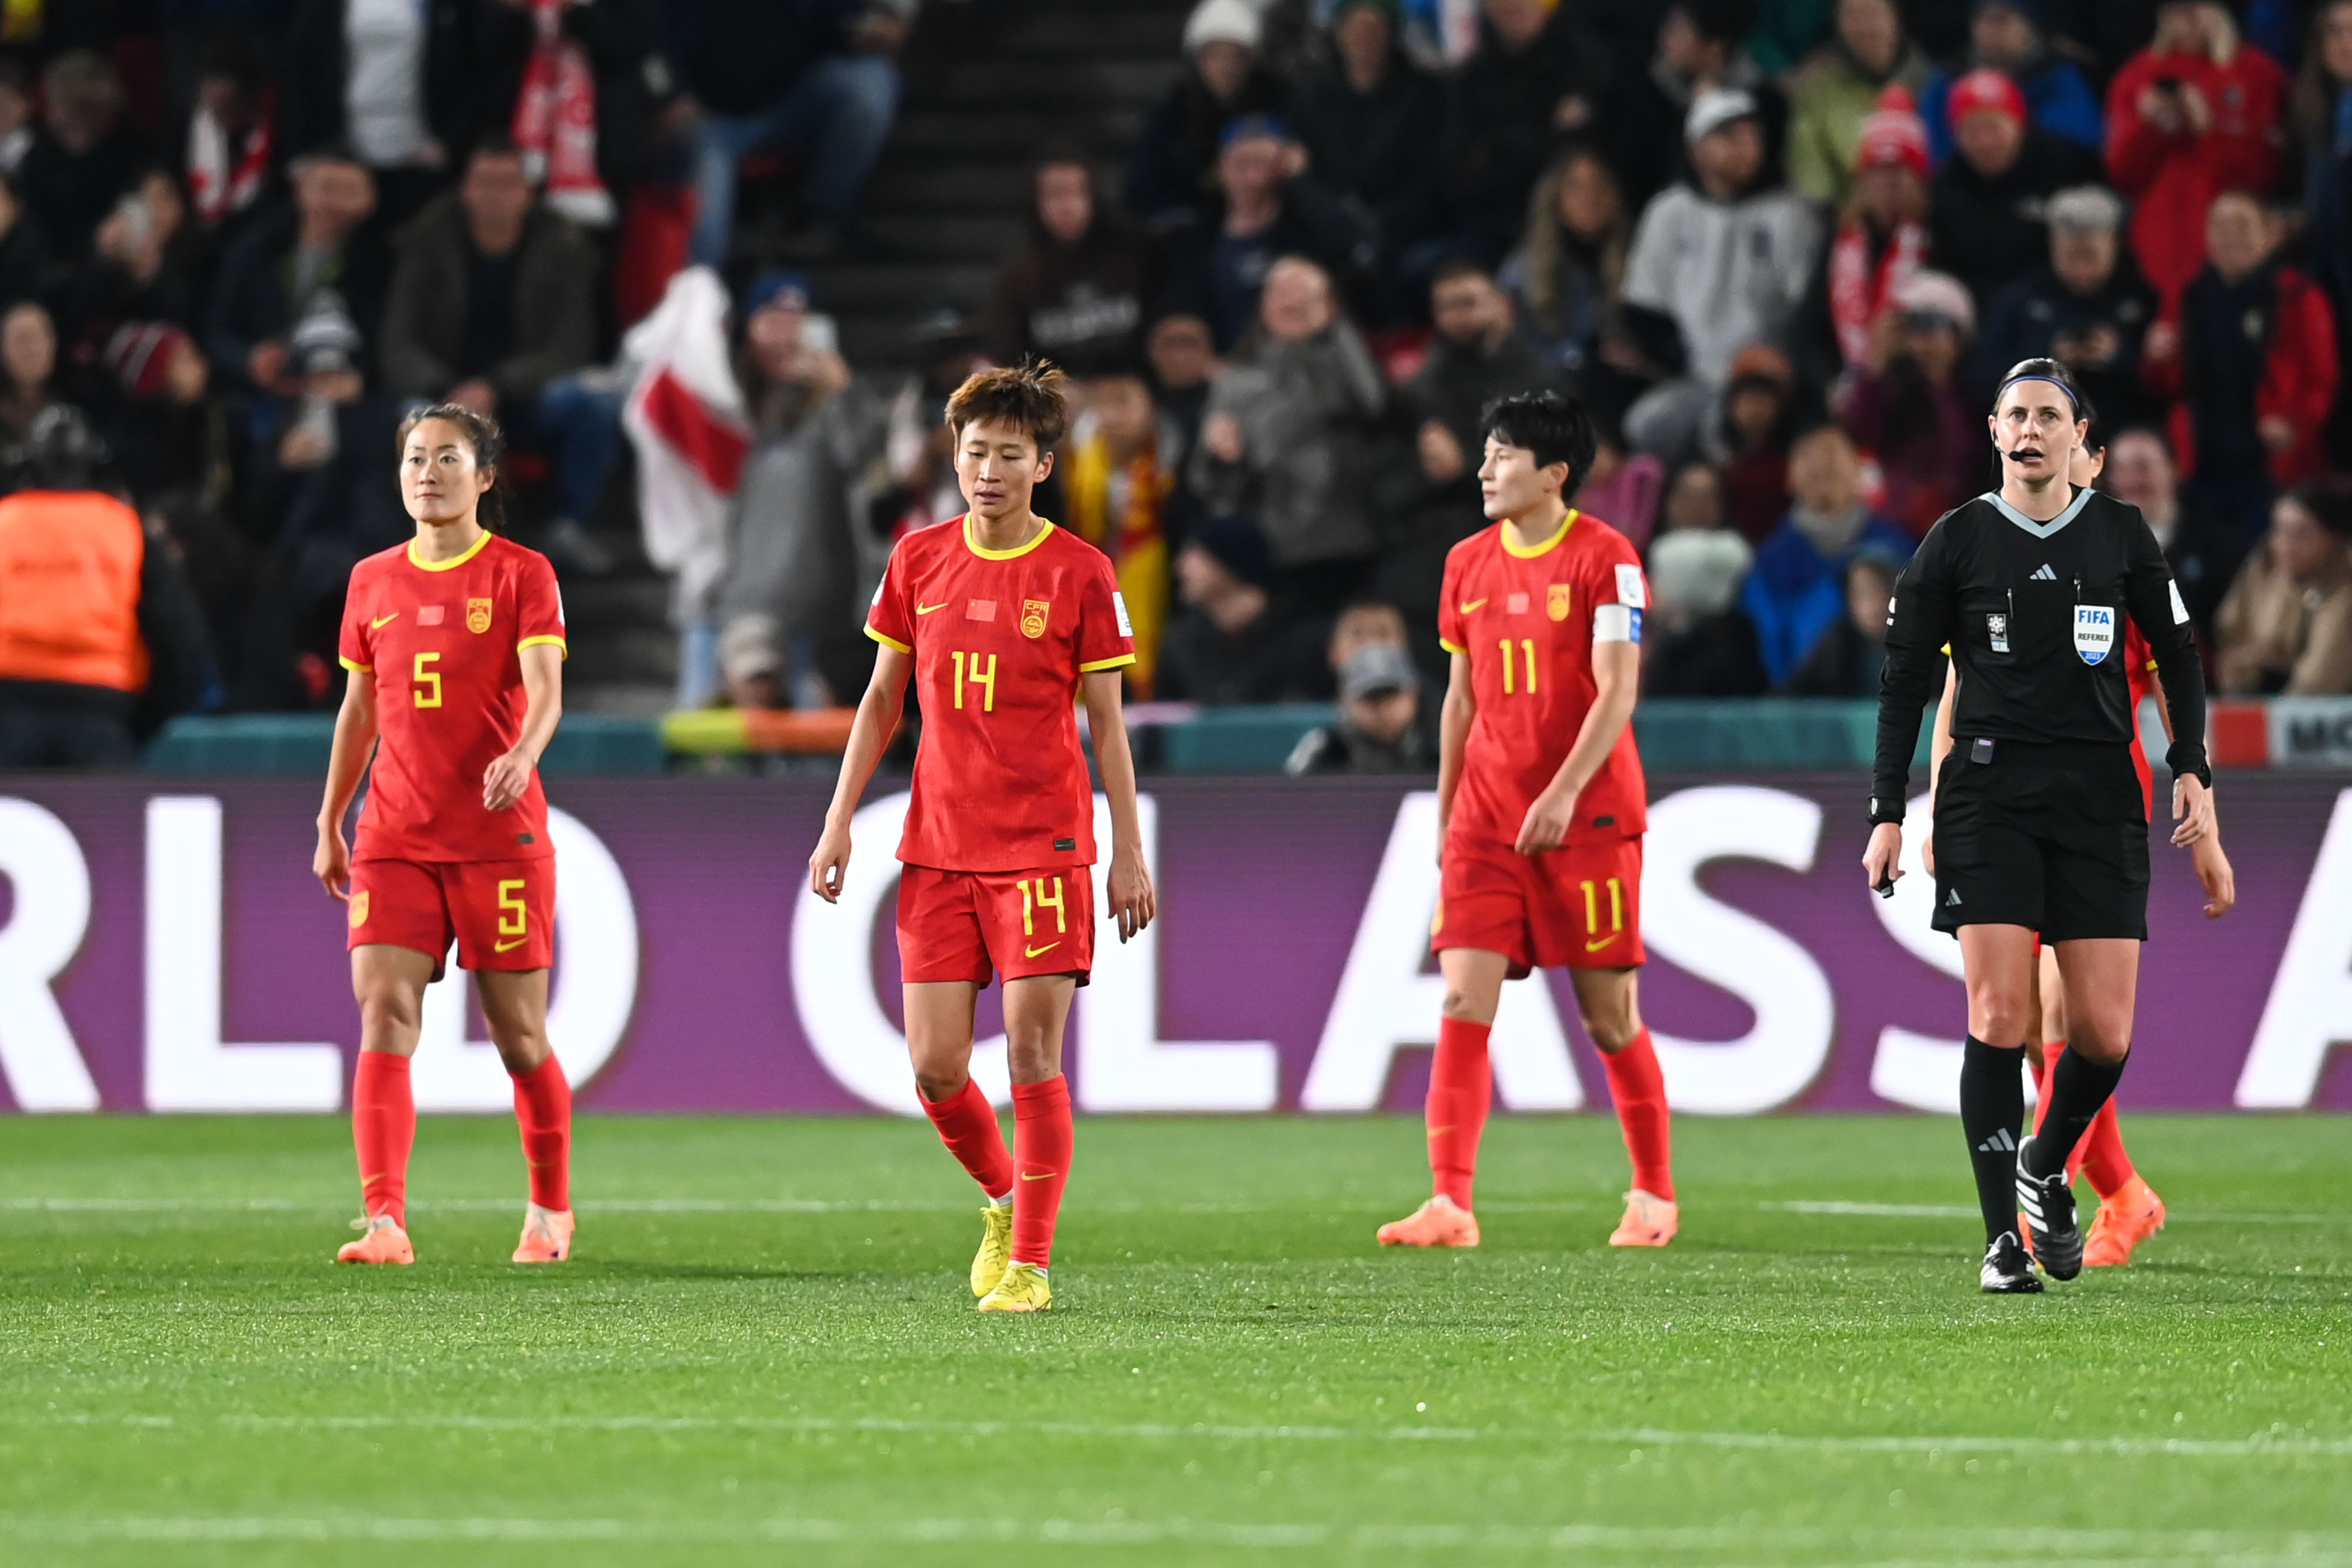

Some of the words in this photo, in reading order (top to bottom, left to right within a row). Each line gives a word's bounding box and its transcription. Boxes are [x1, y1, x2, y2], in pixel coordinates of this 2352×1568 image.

[2077, 633, 2110, 641] REFEREE
[2079, 610, 2110, 624] FIFA
[414, 652, 442, 708] 5
[952, 651, 997, 712] 14
[1499, 639, 1536, 694] 11
[499, 880, 526, 934] 5
[1017, 877, 1066, 936] 14
[1580, 878, 1622, 934] 11
